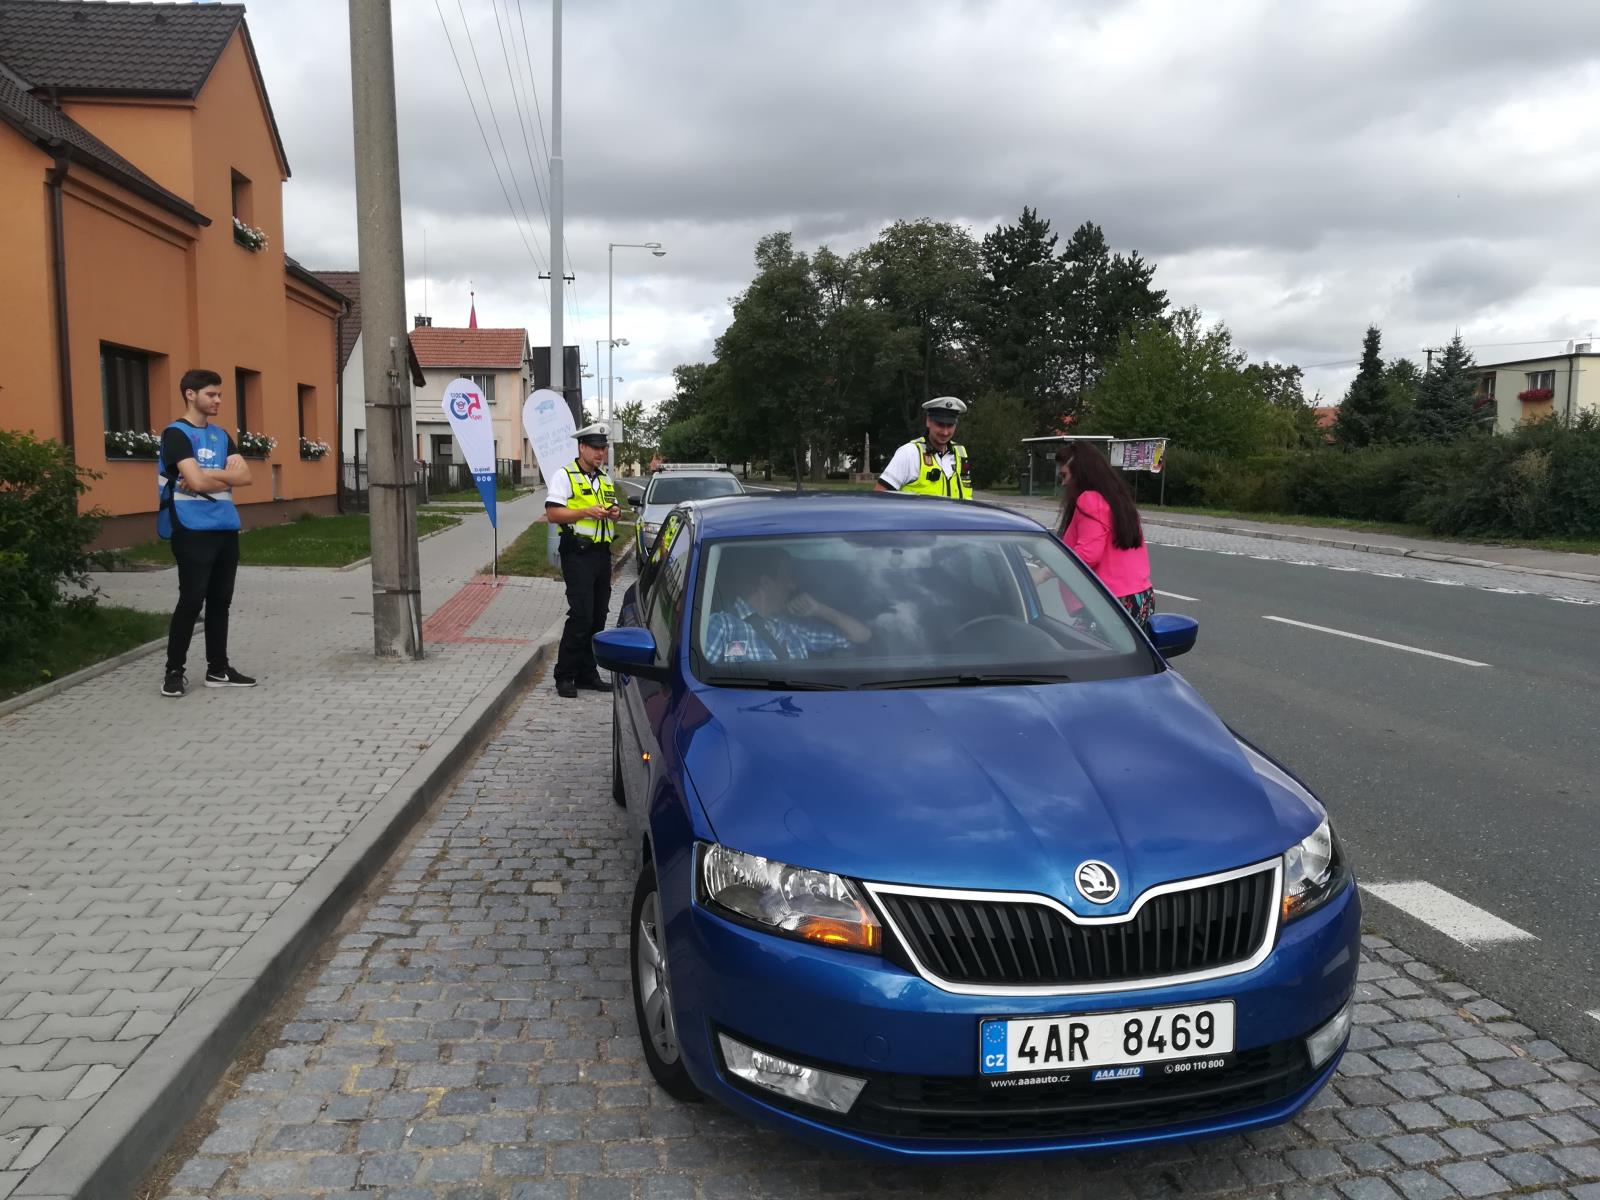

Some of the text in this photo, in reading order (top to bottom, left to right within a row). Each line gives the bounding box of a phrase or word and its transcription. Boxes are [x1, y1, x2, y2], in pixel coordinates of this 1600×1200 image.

[1017, 1010, 1215, 1064] 4AR 8469
[985, 1053, 1005, 1068] CZ
[1174, 1059, 1225, 1073] 800 110 800
[1095, 1067, 1141, 1079] AAA AUTO
[991, 1074, 1071, 1088] www.aaaauto.cz
